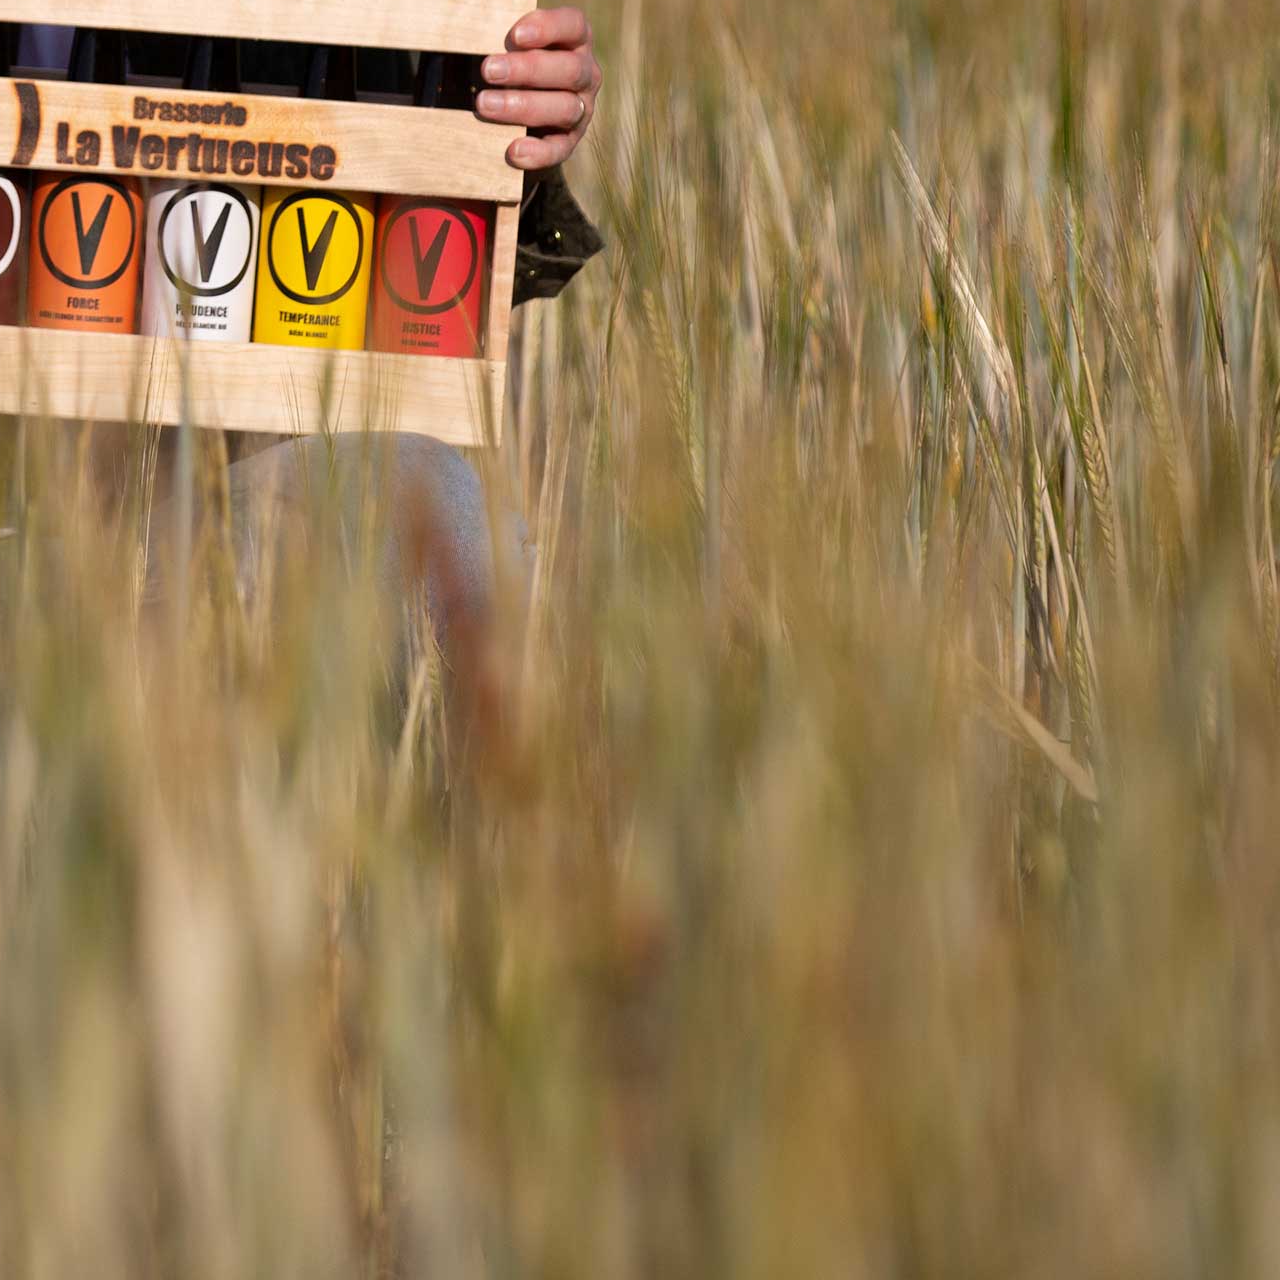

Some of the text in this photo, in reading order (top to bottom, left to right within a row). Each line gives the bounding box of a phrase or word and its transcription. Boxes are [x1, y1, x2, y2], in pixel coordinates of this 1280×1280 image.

[133, 96, 248, 127] Brasserie
[56, 122, 337, 181] La Vertueuse
[71, 191, 115, 276] V
[190, 199, 233, 284] V
[296, 206, 340, 292] V
[408, 215, 453, 301] V
[66, 296, 100, 310] FORCE
[401, 321, 441, 336] JUSTICE
